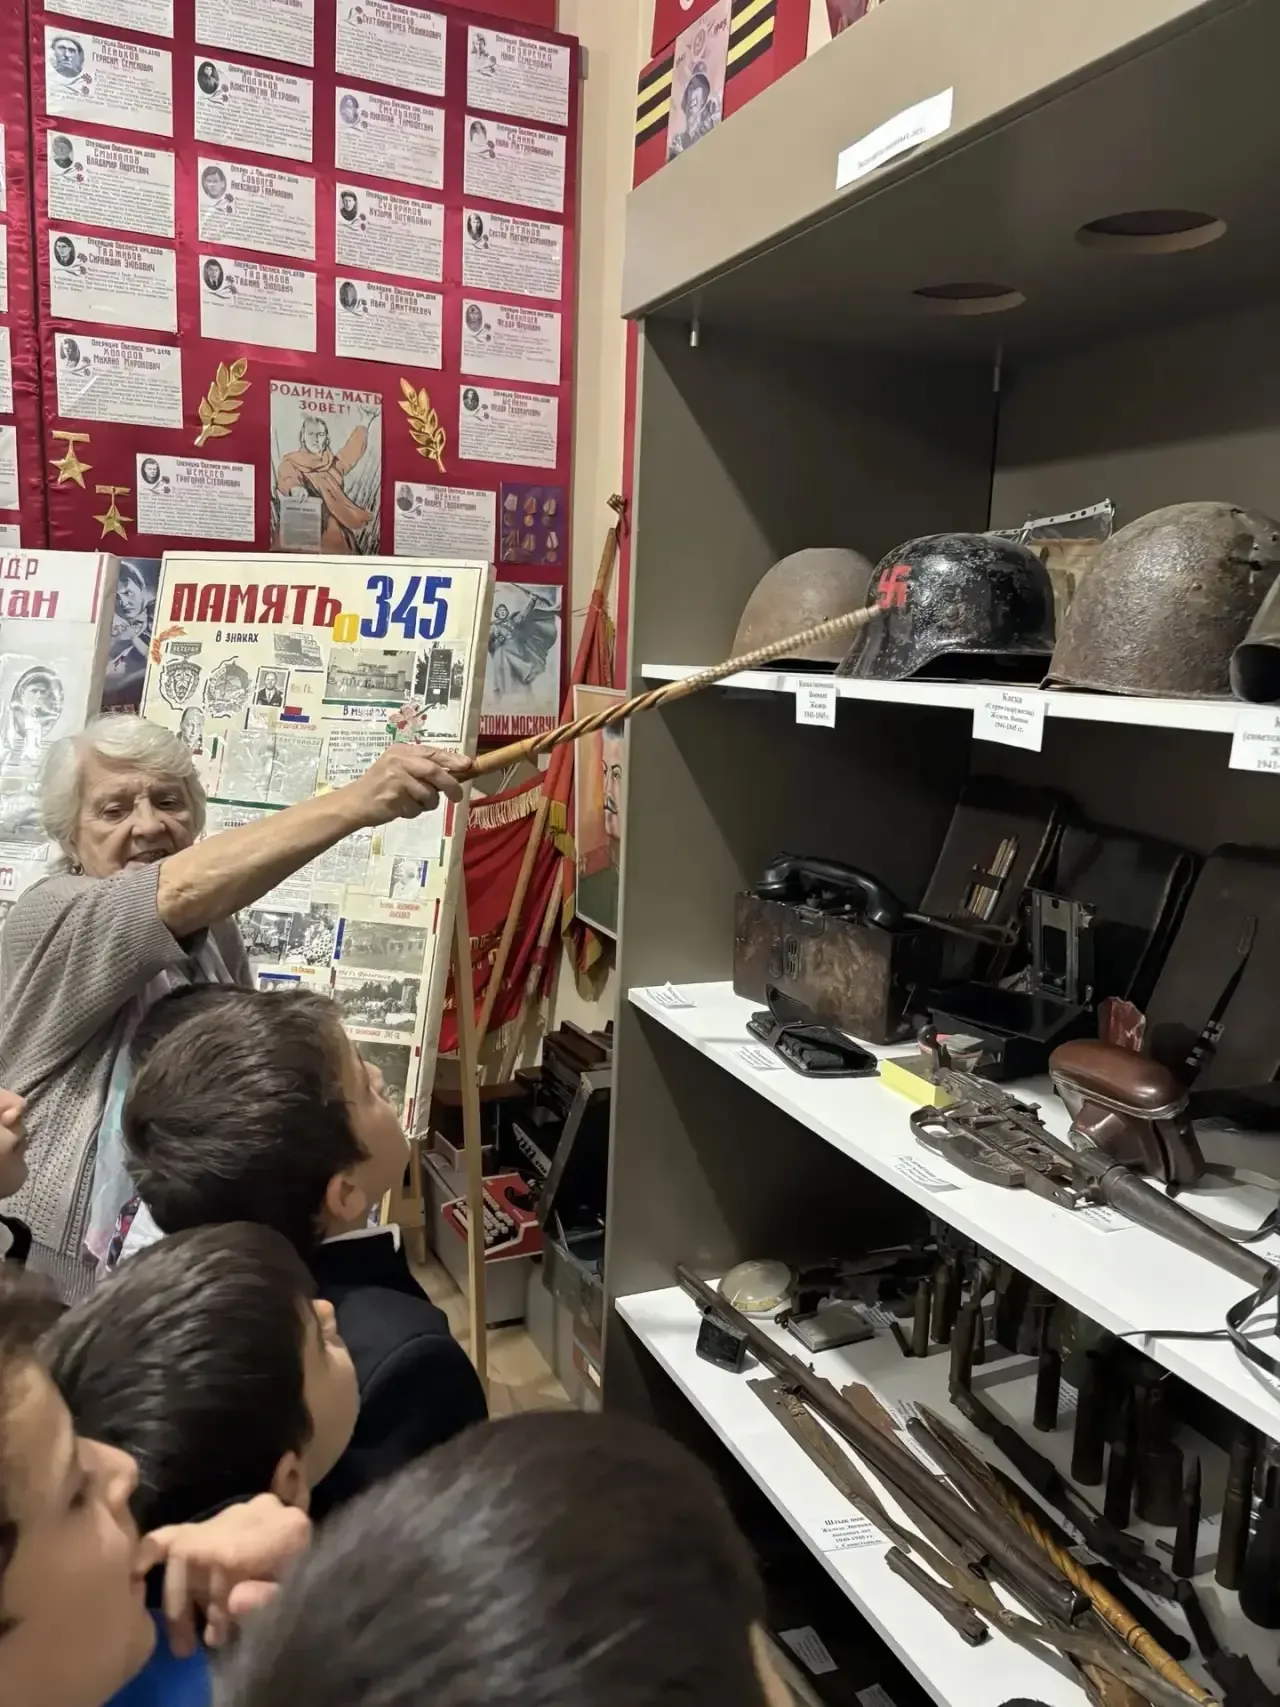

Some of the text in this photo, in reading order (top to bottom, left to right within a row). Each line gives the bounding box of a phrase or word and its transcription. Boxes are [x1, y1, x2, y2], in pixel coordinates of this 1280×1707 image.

[170, 583, 342, 628] ПАМЯТЬ
[360, 575, 452, 640] 345
[225, 632, 259, 642] ЗНАКАХ
